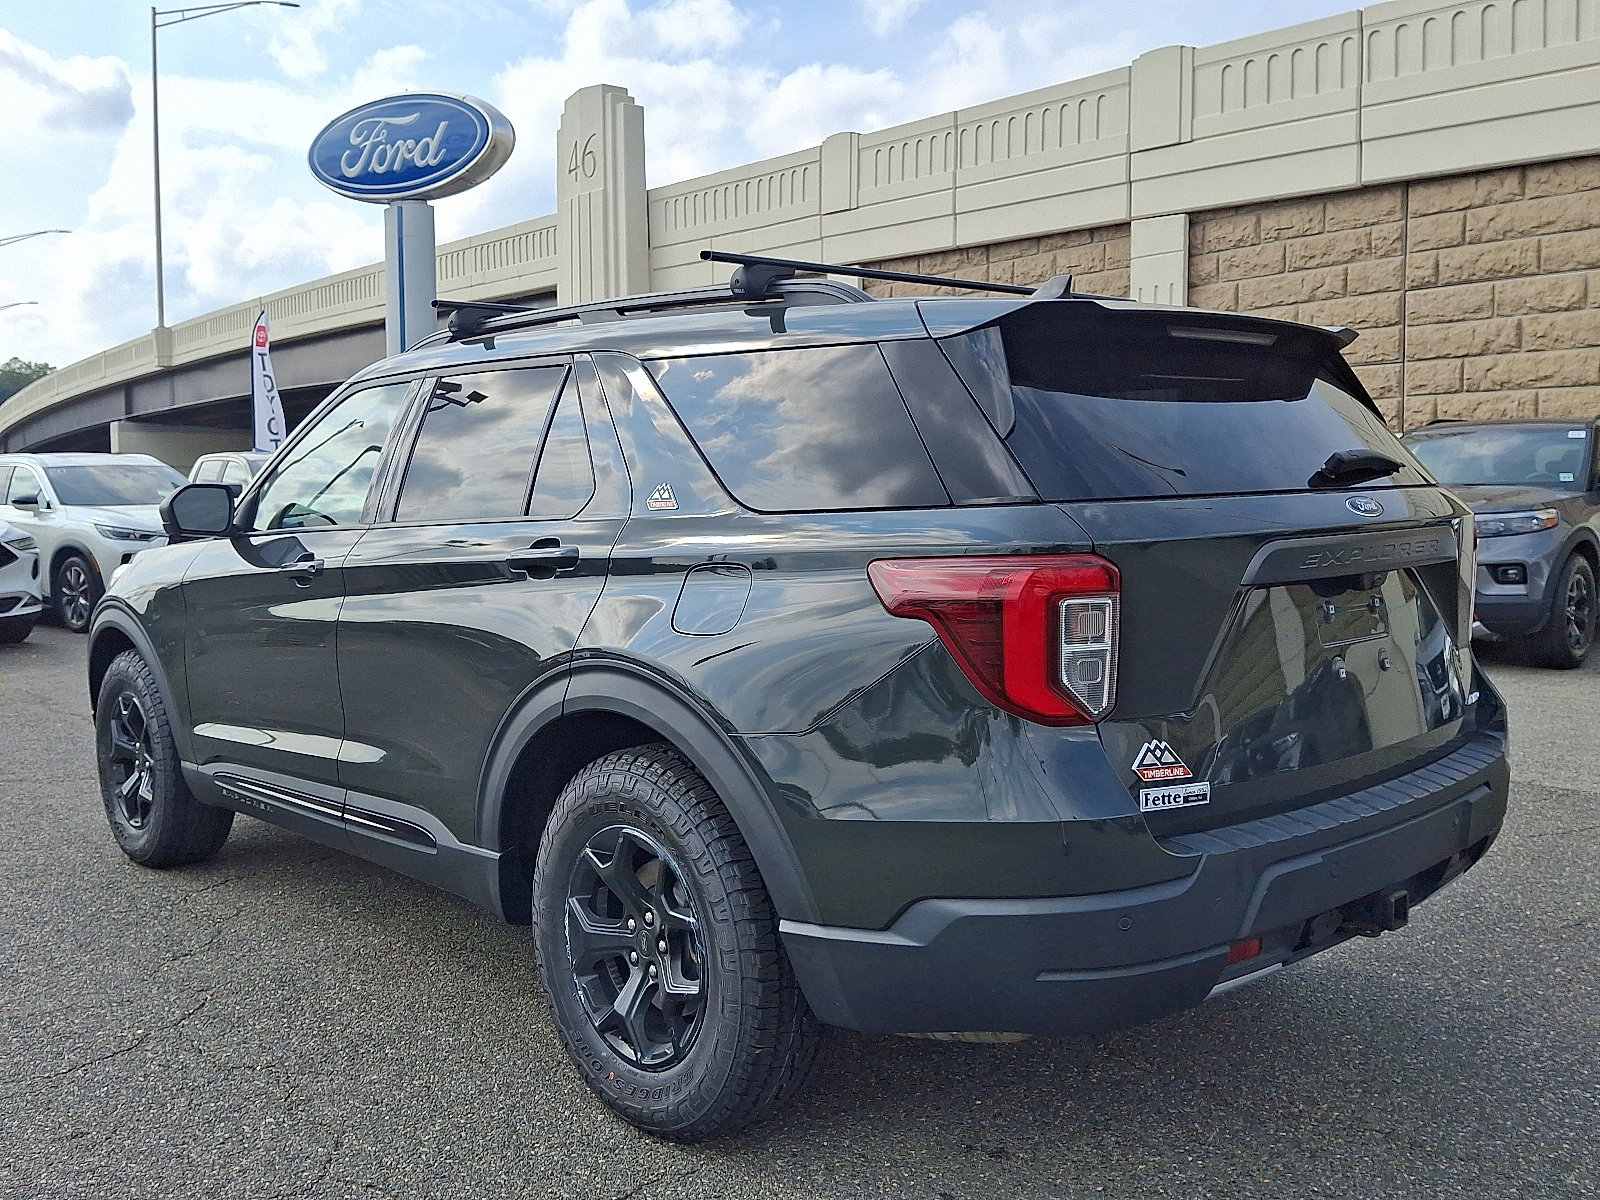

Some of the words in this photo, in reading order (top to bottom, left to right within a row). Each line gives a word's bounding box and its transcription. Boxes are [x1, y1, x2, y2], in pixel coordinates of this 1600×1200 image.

[340, 112, 450, 178] Ford
[567, 132, 598, 183] 46
[1299, 539, 1439, 569] EXPLORER
[1143, 767, 1184, 778] TIMBERLINE
[1144, 791, 1182, 807] Fette
[568, 1028, 696, 1102] BRIDGESTONE
